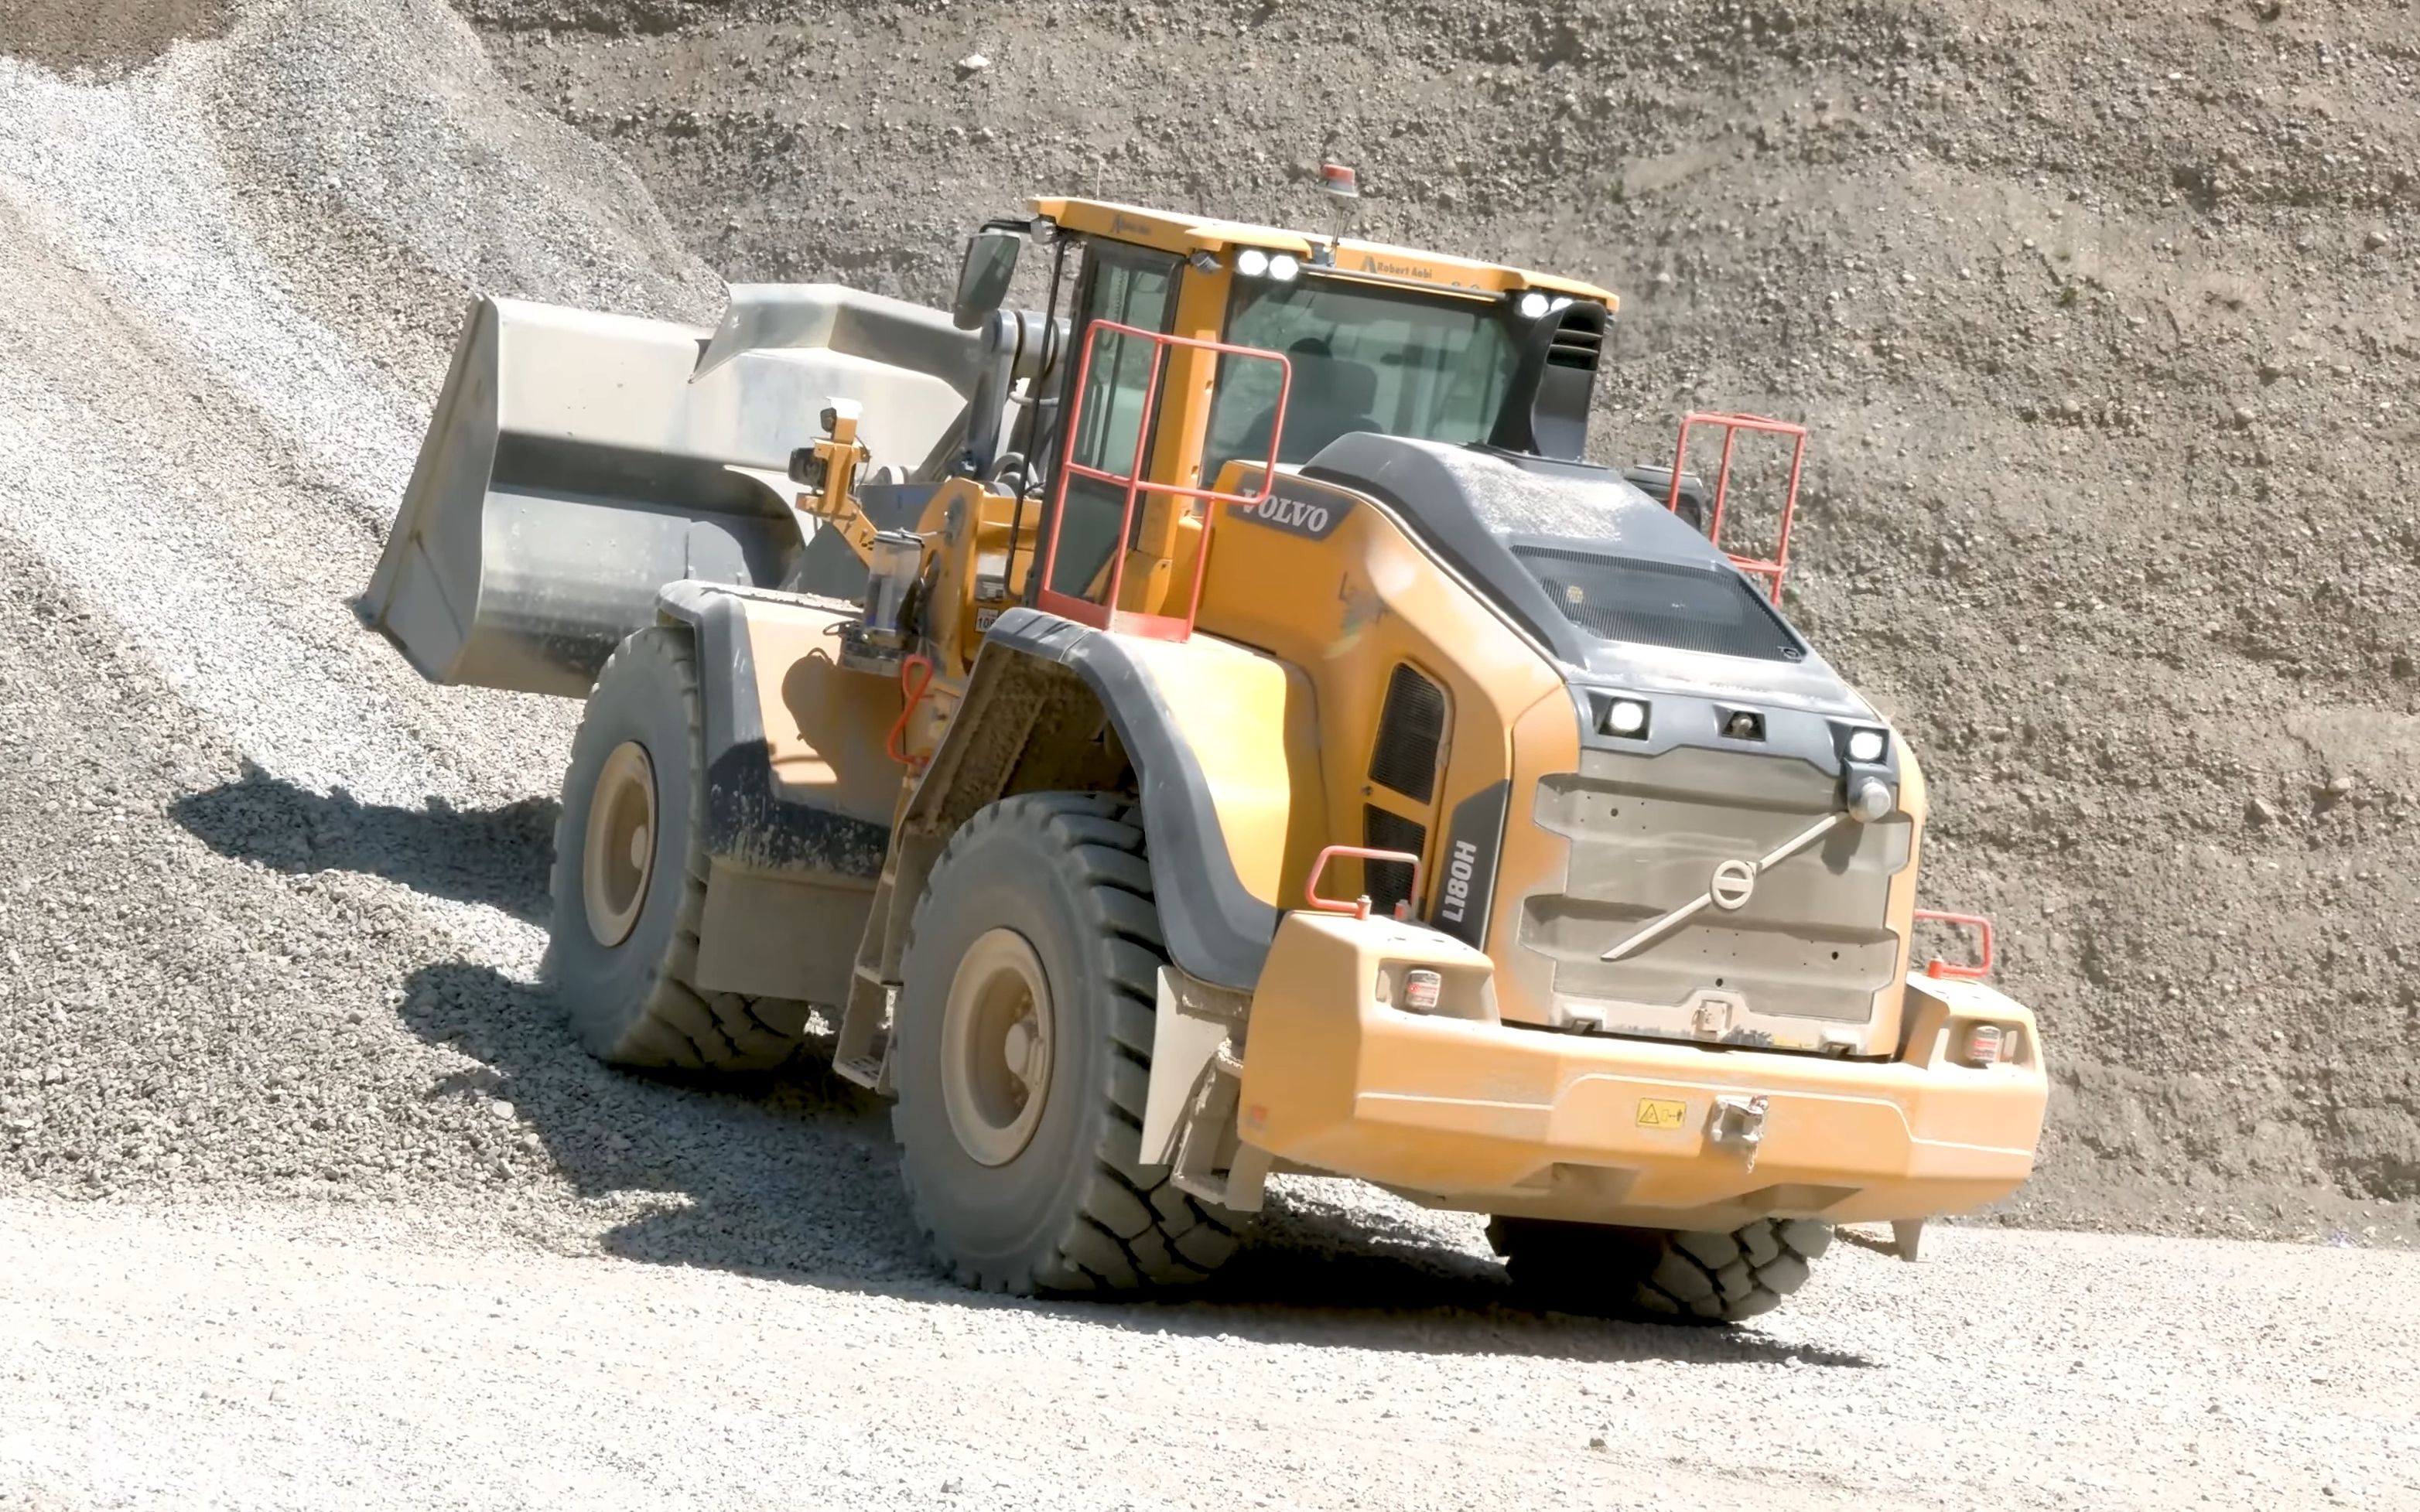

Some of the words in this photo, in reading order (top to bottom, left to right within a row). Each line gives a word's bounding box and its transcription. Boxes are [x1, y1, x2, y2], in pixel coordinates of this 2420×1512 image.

[1377, 262, 1409, 275] Robert
[1242, 488, 1328, 532] VOLVO
[1442, 840, 1477, 922] L180H
